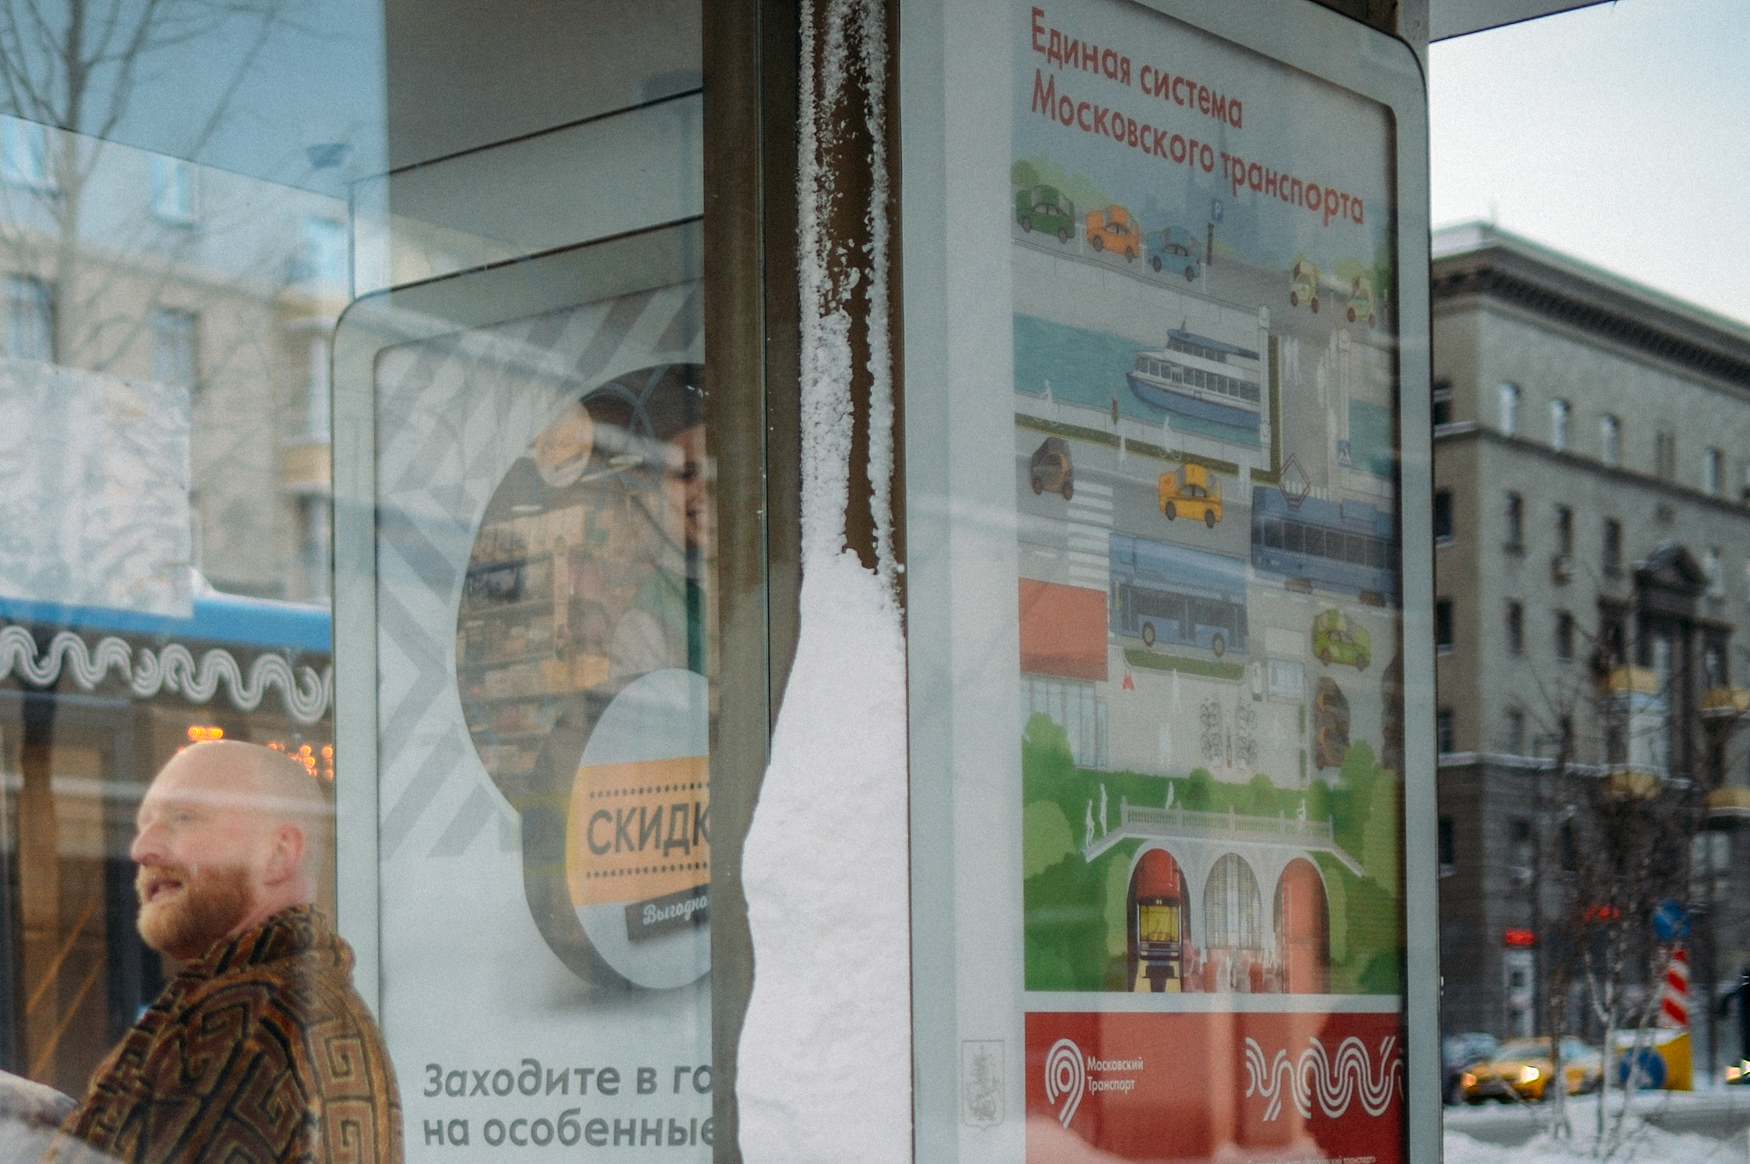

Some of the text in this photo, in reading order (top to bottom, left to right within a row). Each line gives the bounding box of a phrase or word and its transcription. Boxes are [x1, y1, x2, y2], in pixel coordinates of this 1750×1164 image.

[1031, 7, 1243, 129] Единая система
[1031, 69, 1364, 226] Московского транспорта
[422, 1058, 620, 1098] Заходите
[636, 1067, 657, 1095] в
[1087, 1056, 1144, 1071] Московский
[1087, 1076, 1135, 1096] Транспорт
[423, 1118, 470, 1146] на
